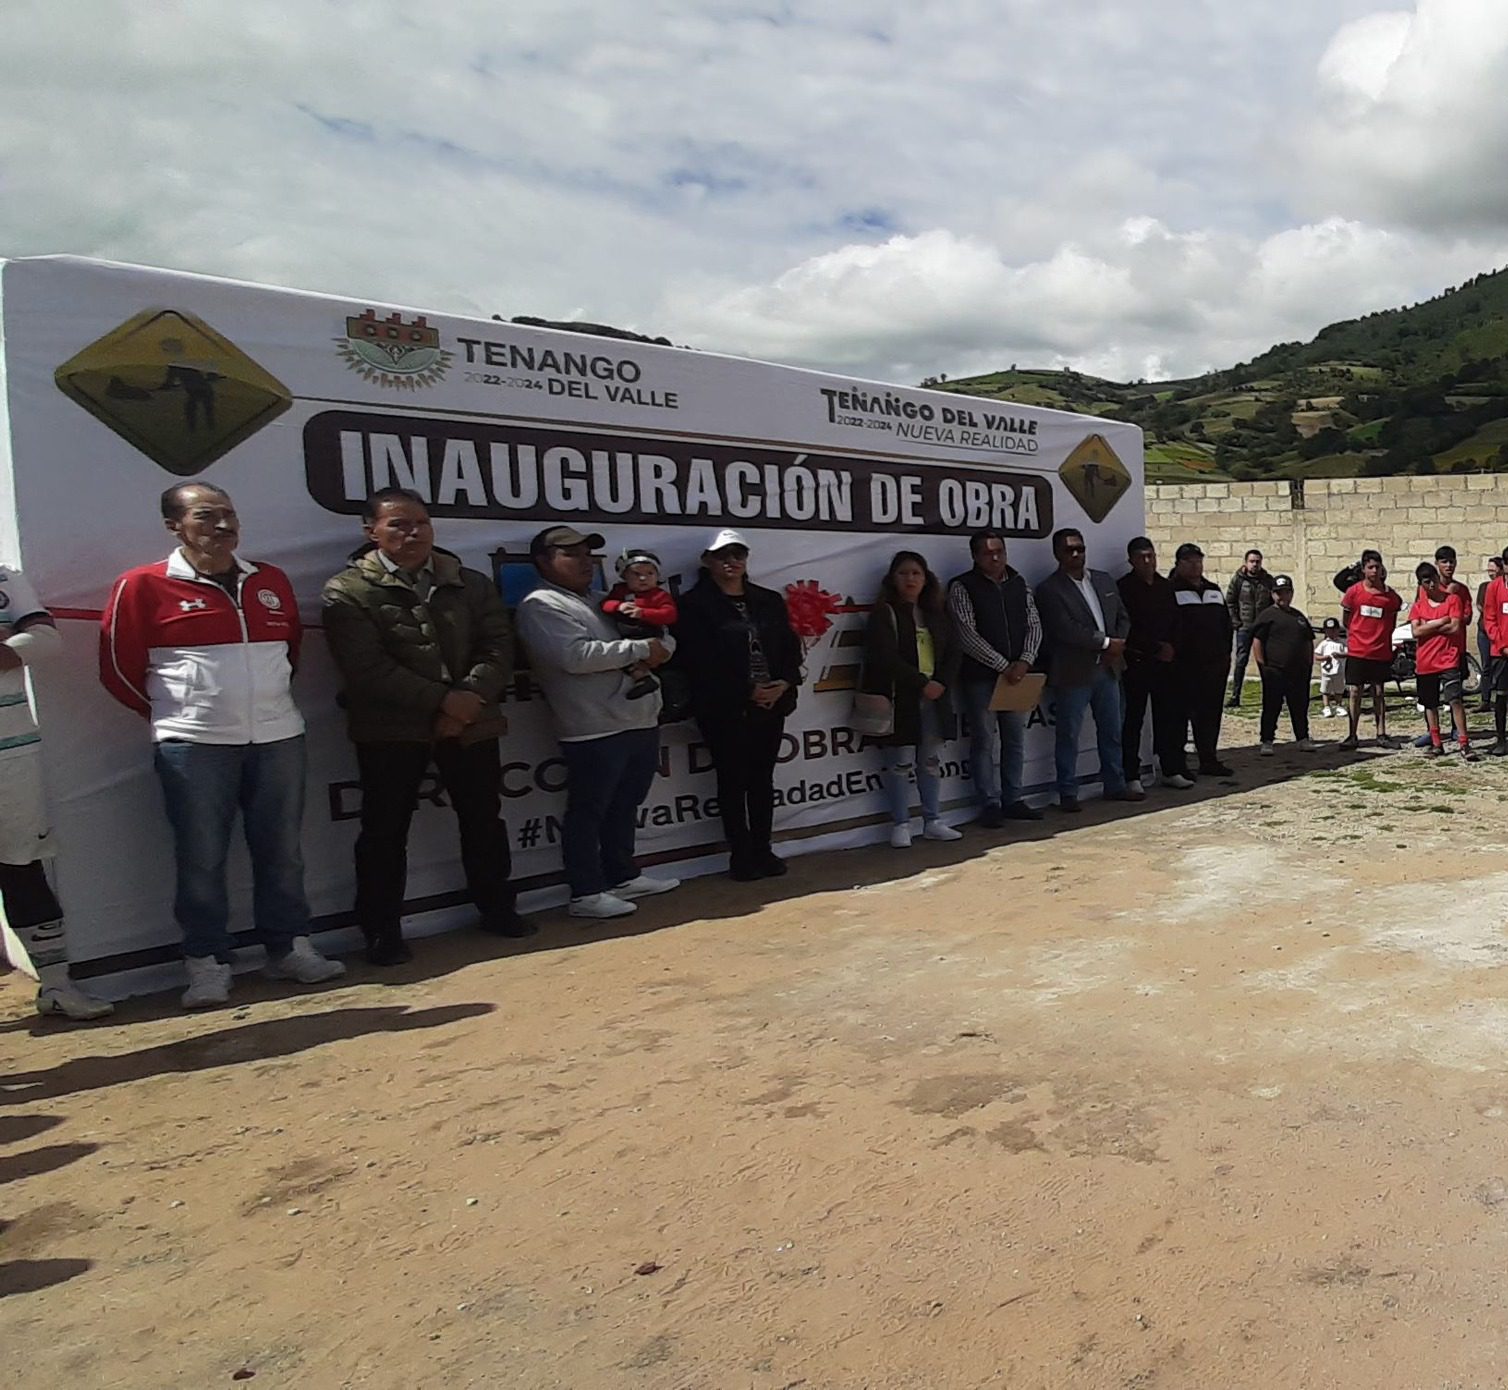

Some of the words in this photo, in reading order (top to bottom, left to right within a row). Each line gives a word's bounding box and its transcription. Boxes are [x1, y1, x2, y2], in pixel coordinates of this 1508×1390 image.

[457, 338, 641, 383] TENANGO
[464, 371, 543, 390] 2022-2024
[548, 378, 598, 400] DEL
[604, 384, 678, 409] VALLE
[836, 415, 892, 430] 2022-2024
[896, 421, 955, 444] NUEVA
[960, 430, 1039, 452] REALIDAD
[942, 407, 978, 428] DEL
[983, 413, 1038, 435] VALLE
[340, 429, 853, 522] INAUGURACIÓN
[870, 472, 925, 526] DE
[938, 478, 1040, 531] OBRA
